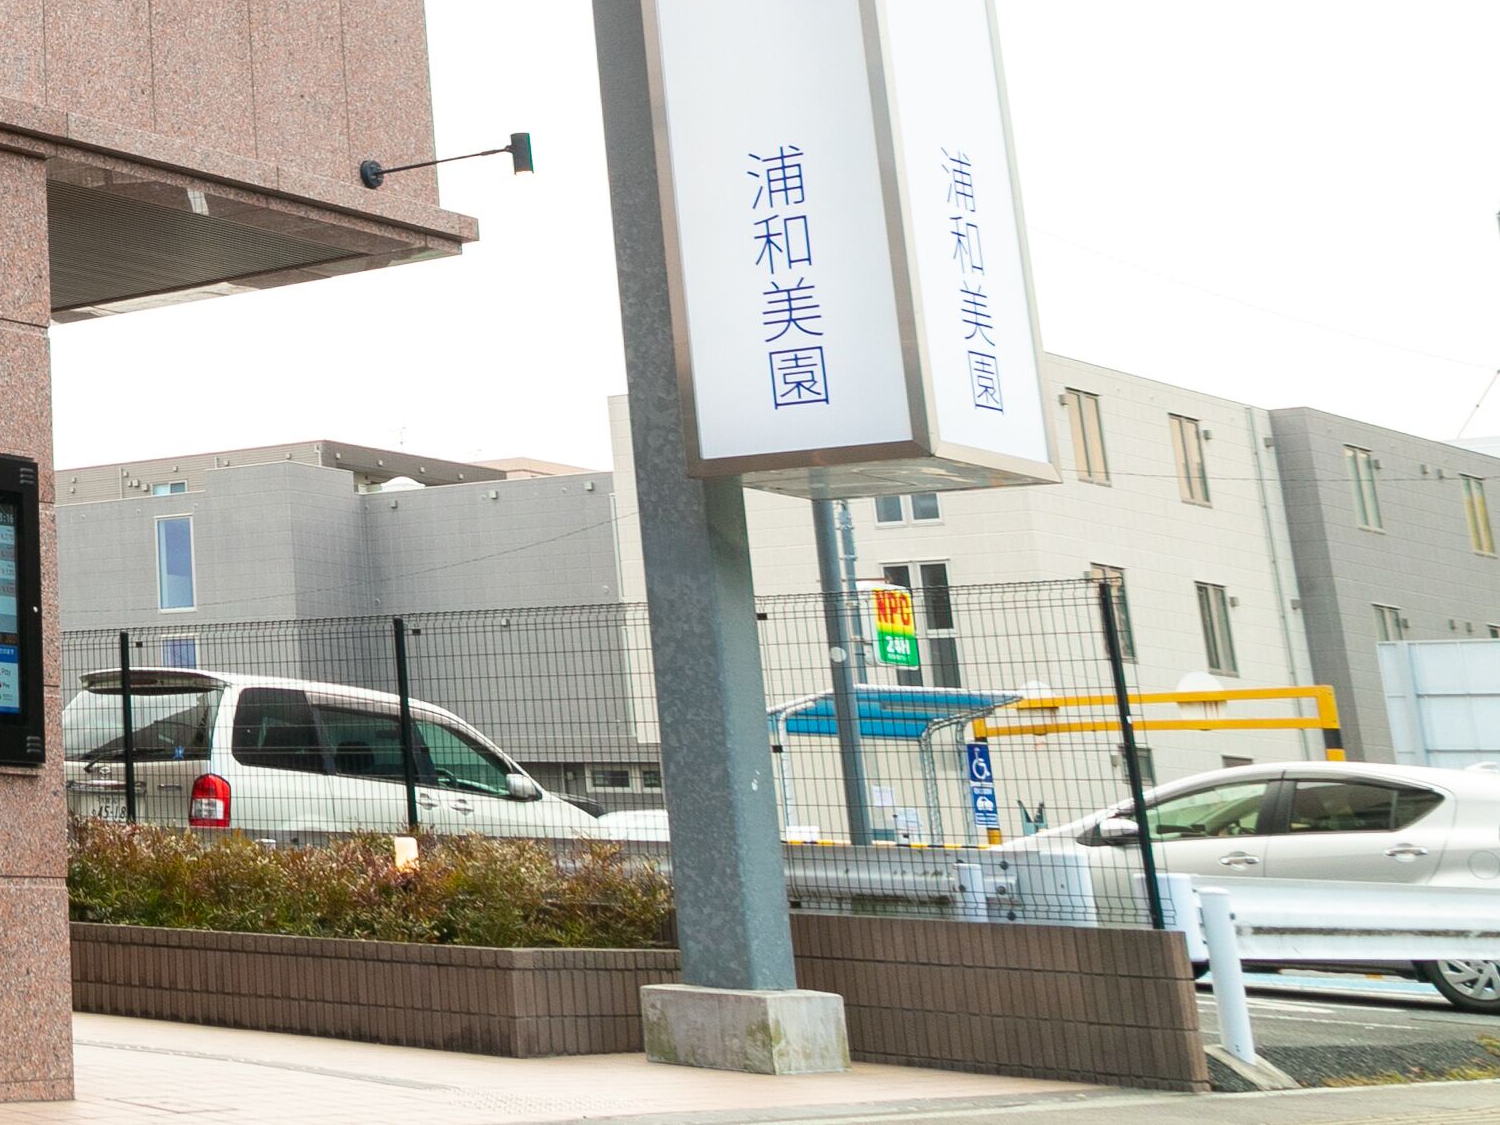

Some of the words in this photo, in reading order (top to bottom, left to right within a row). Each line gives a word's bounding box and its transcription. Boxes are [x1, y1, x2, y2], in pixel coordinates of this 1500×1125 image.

[746, 144, 830, 411] 浦和美園
[940, 146, 1004, 415] 浦和美園
[873, 590, 911, 626] NPC
